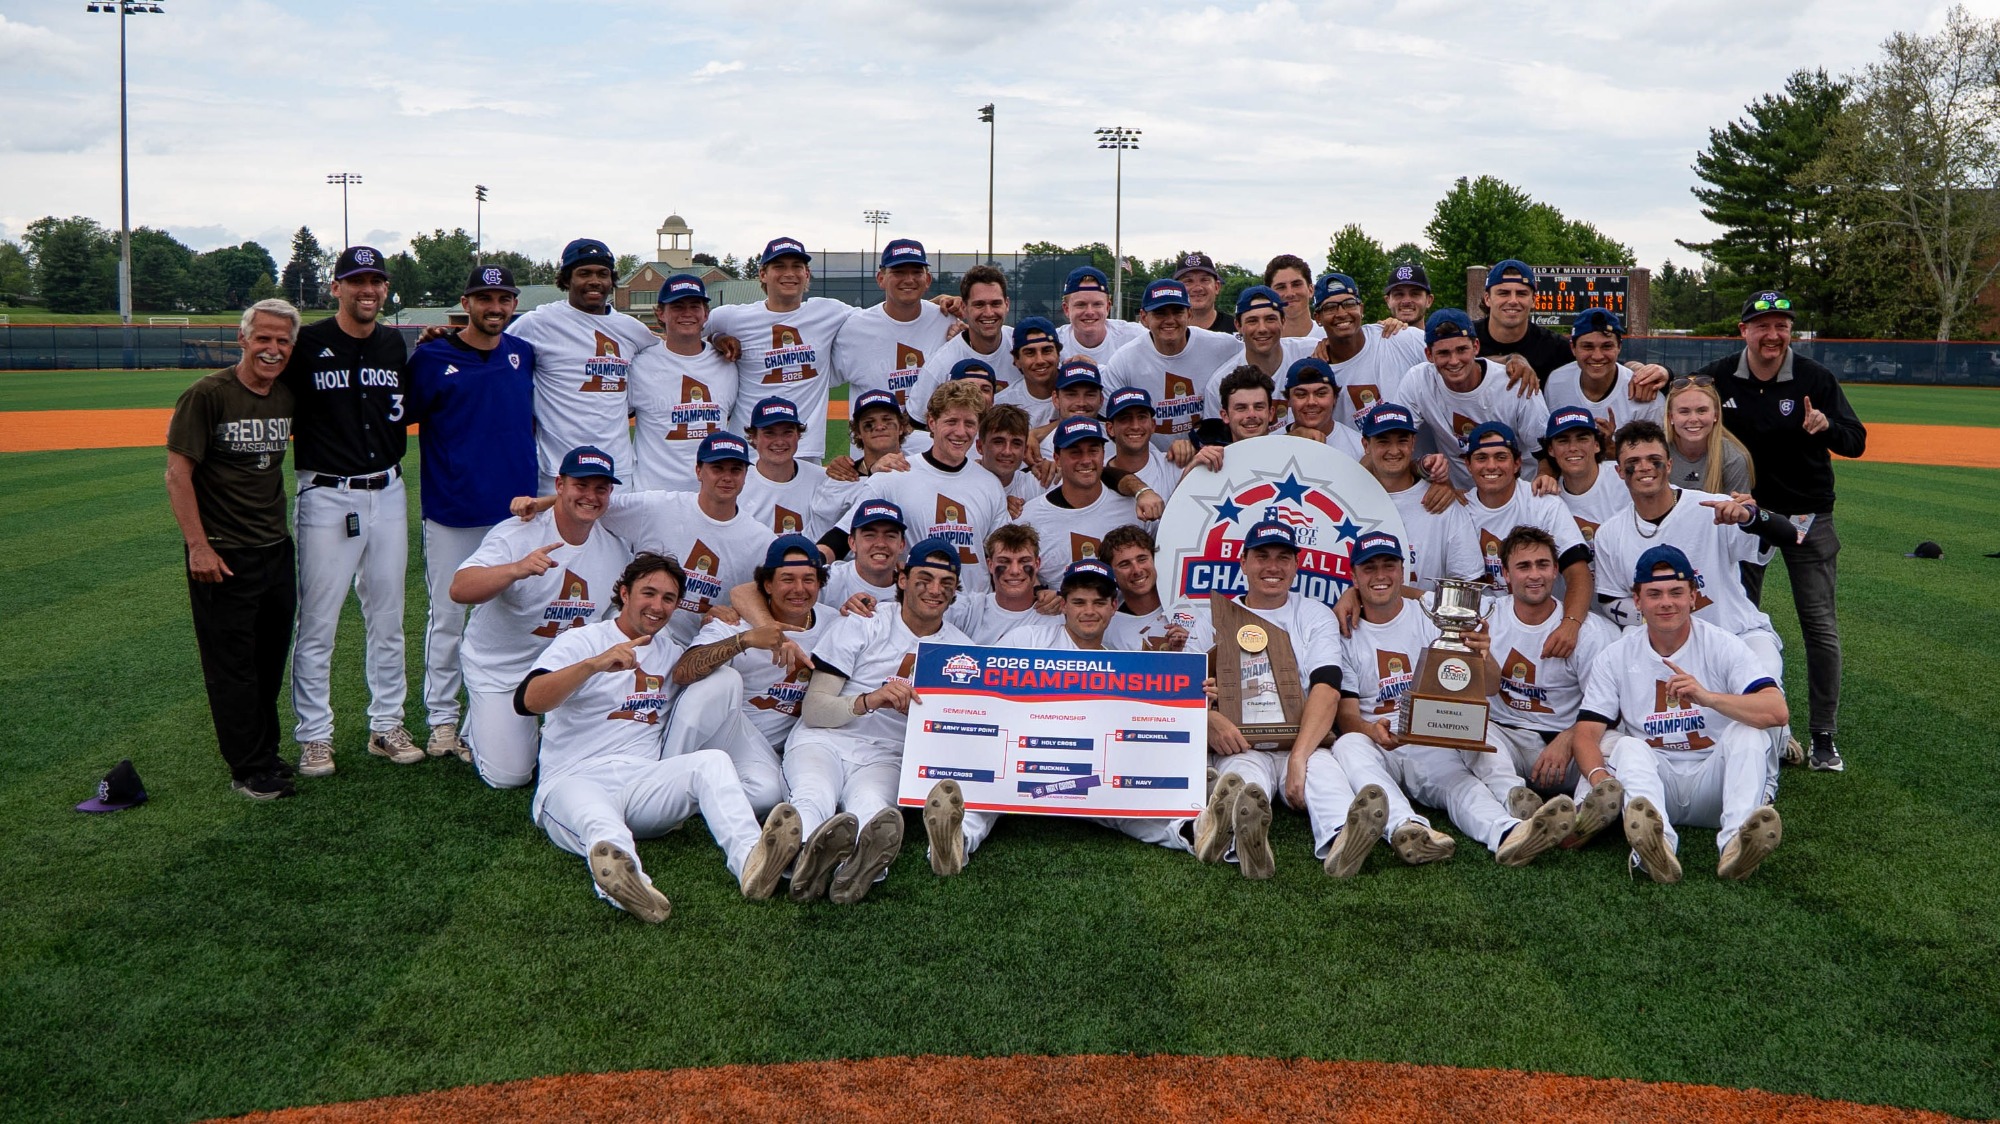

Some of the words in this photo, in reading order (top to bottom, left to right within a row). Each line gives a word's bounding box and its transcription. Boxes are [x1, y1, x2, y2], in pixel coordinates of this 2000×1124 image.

[1560, 282, 1566, 290] 0
[1589, 282, 1594, 291] 0
[766, 347, 791, 357] PATRIOT
[764, 350, 816, 369] CHAMPIONS
[314, 370, 350, 390] HOLY
[360, 368, 399, 388] CROSS
[782, 372, 803, 382] 2026
[890, 370, 912, 378] PATRIOT
[888, 376, 918, 391] CHAMP
[388, 394, 405, 422] 3
[1156, 400, 1204, 418] CHAMPIONS
[672, 409, 721, 424] CHAMPIONS
[224, 418, 264, 442] RED
[268, 418, 292, 441] SOX
[687, 430, 708, 438] 2026
[1172, 423, 1193, 433] 2026
[231, 442, 280, 452] BASEBALL
[701, 574, 723, 586] LEAGUE
[686, 578, 722, 598] MPIONS
[986, 657, 1030, 669] 2026
[1034, 659, 1116, 672] BASEBALL
[1242, 662, 1272, 681] CHAMP
[984, 669, 1190, 693] CHAMPIONSHIP
[943, 708, 987, 716] SEMIFINALS
[1436, 709, 1463, 717] BASEBALL
[1646, 713, 1674, 721] PATRIOT
[1676, 710, 1700, 718] LEAGUE
[1427, 721, 1470, 732] CHAMPIONS
[1644, 716, 1706, 736] CHAMPIONS
